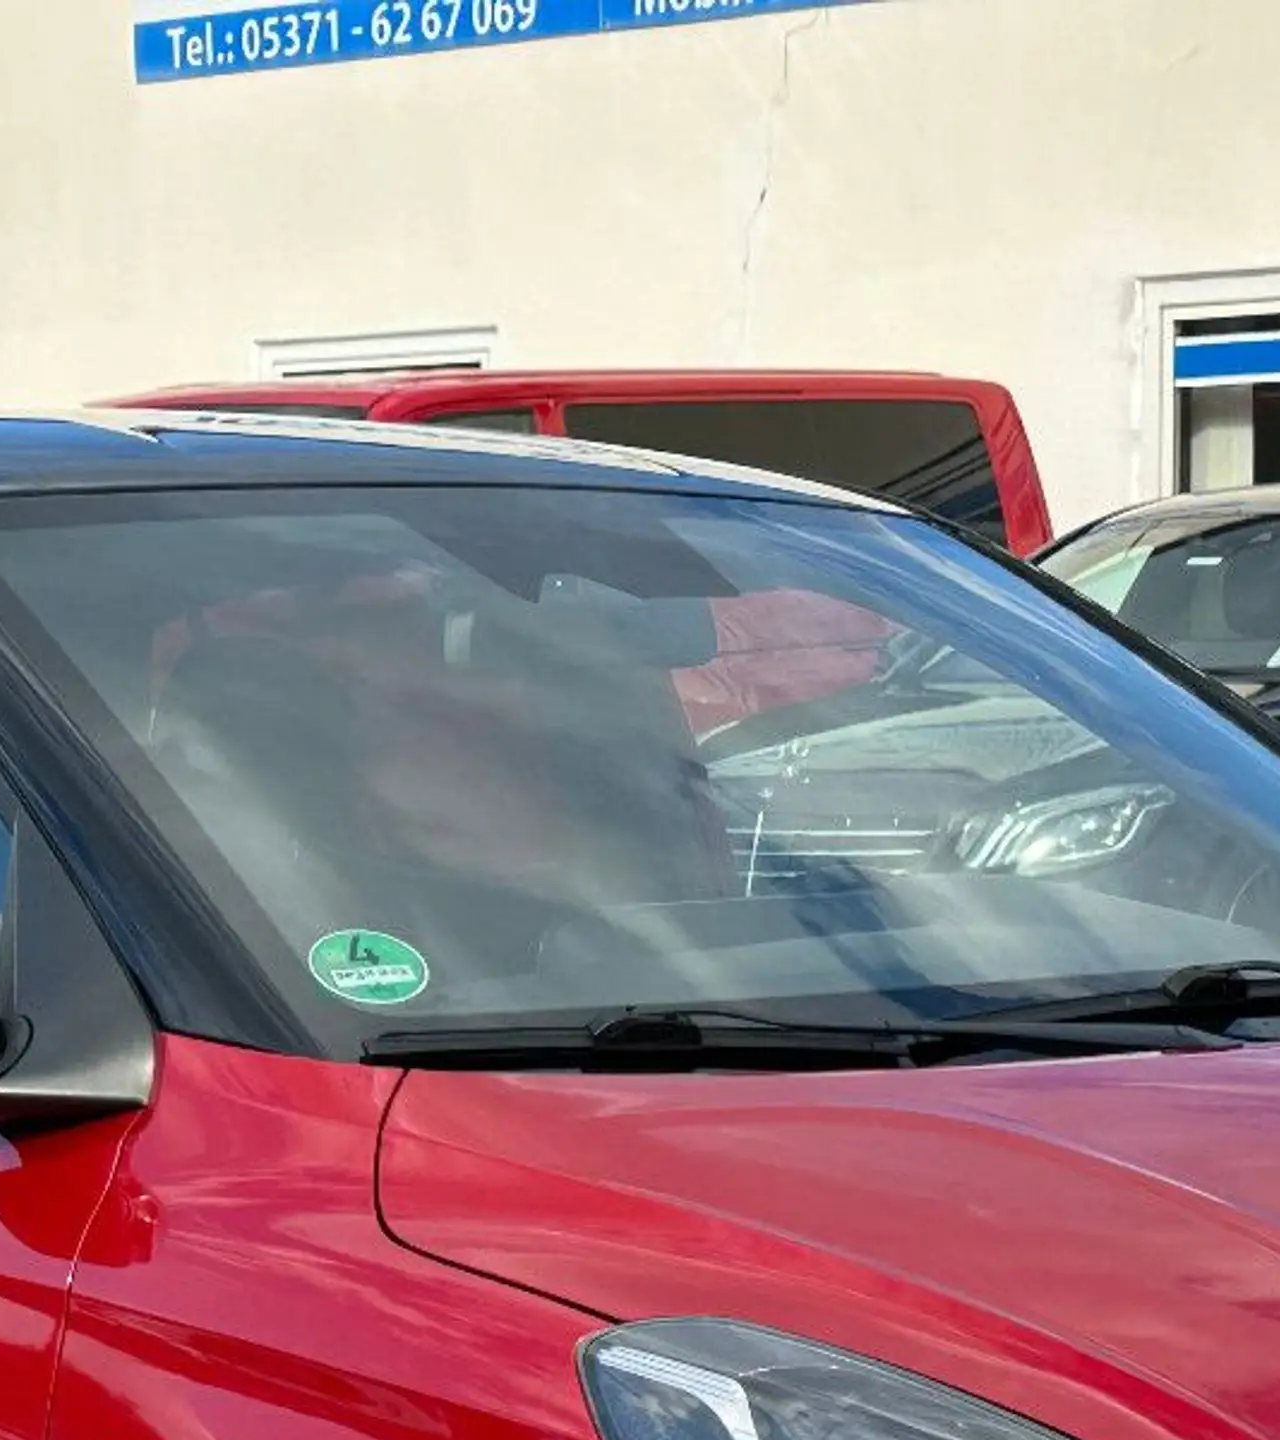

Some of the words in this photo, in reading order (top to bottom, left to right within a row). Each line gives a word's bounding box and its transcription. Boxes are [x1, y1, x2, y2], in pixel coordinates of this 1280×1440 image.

[166, 21, 234, 69] Tel.:
[241, 9, 340, 62] 05371
[371, 2, 413, 46] 62
[421, 0, 462, 40] 67
[472, 0, 537, 36] 069
[349, 932, 381, 966] 4
